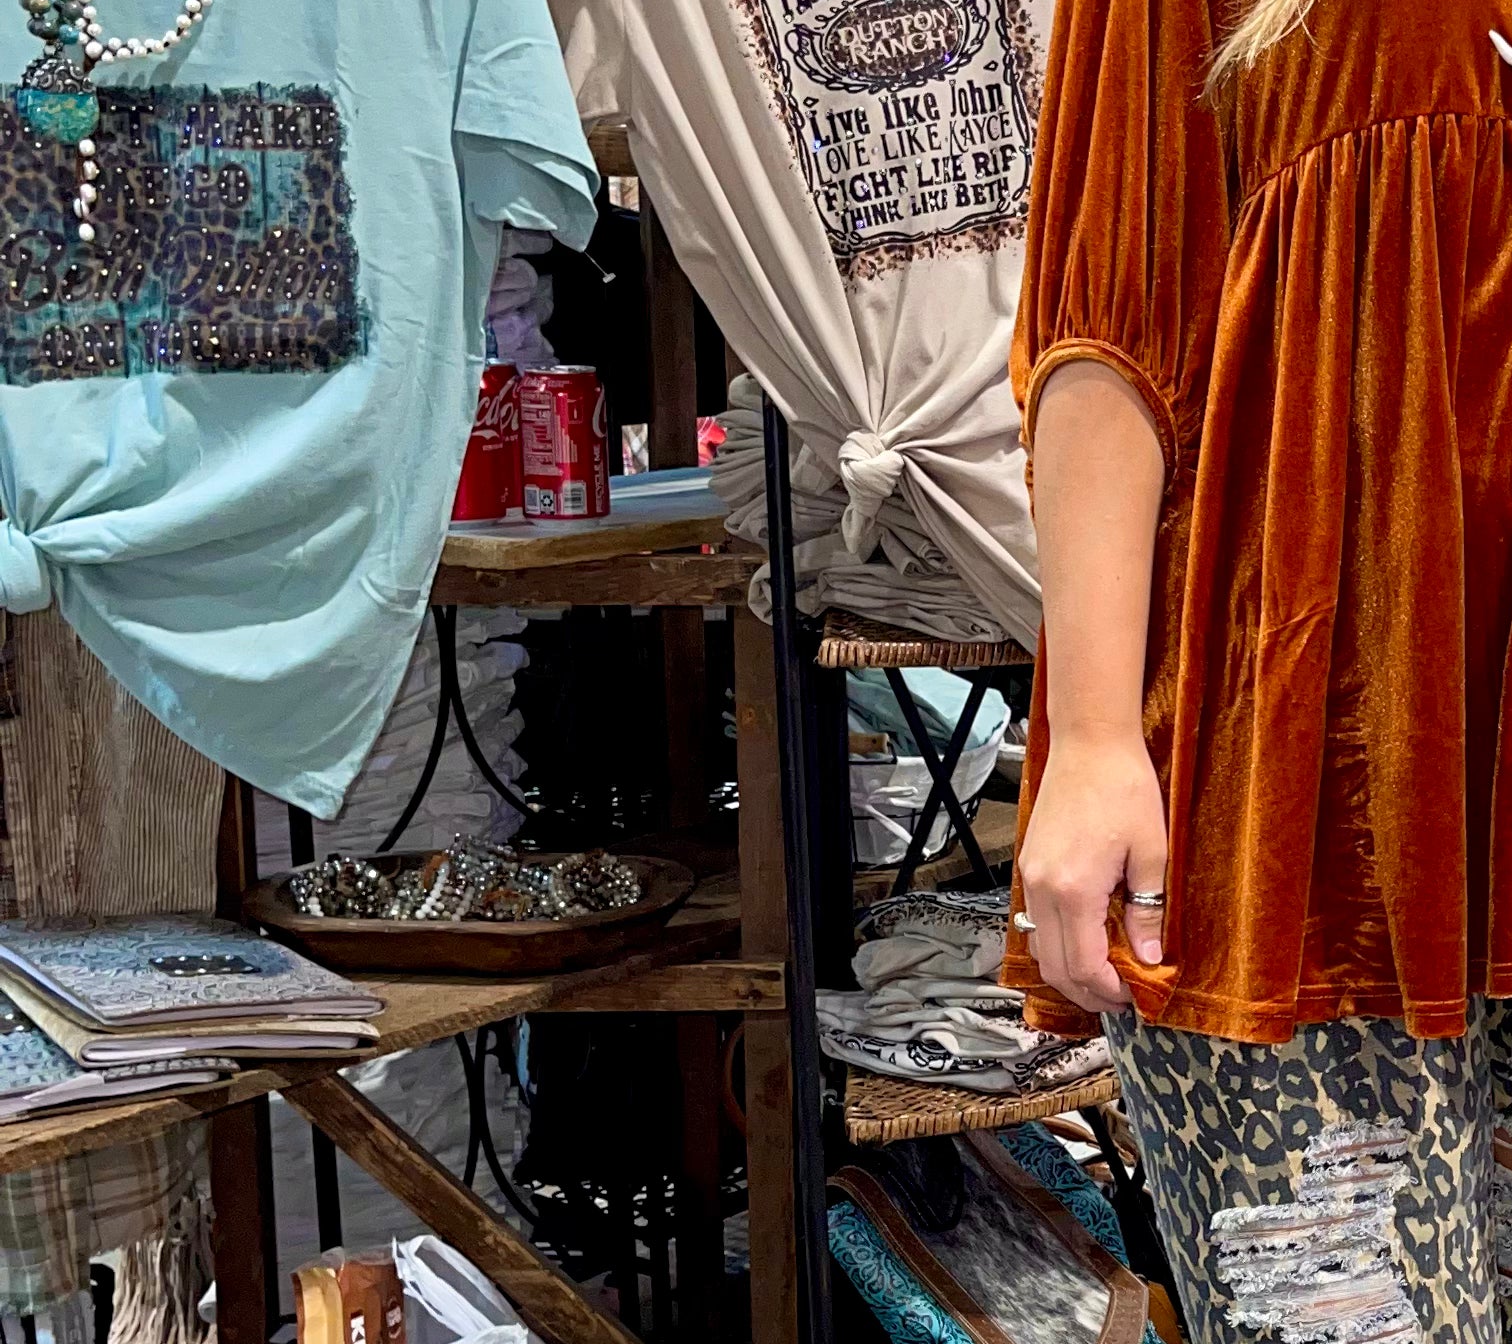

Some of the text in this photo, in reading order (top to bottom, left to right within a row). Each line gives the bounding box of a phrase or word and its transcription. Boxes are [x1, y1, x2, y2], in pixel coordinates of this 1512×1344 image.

[839, 8, 949, 48] DUTTON
[851, 28, 948, 65] RANCH
[949, 80, 1005, 118] John
[181, 105, 338, 149] MAKE
[813, 111, 1013, 185] LOVE LIKE KAYCE
[183, 163, 249, 207] GO
[823, 144, 1017, 212] FIGHT LIKE RIP
[835, 176, 1010, 234] THINK LIKE BETH
[2, 222, 342, 312] Beth Dutton
[41, 322, 124, 370] ON
